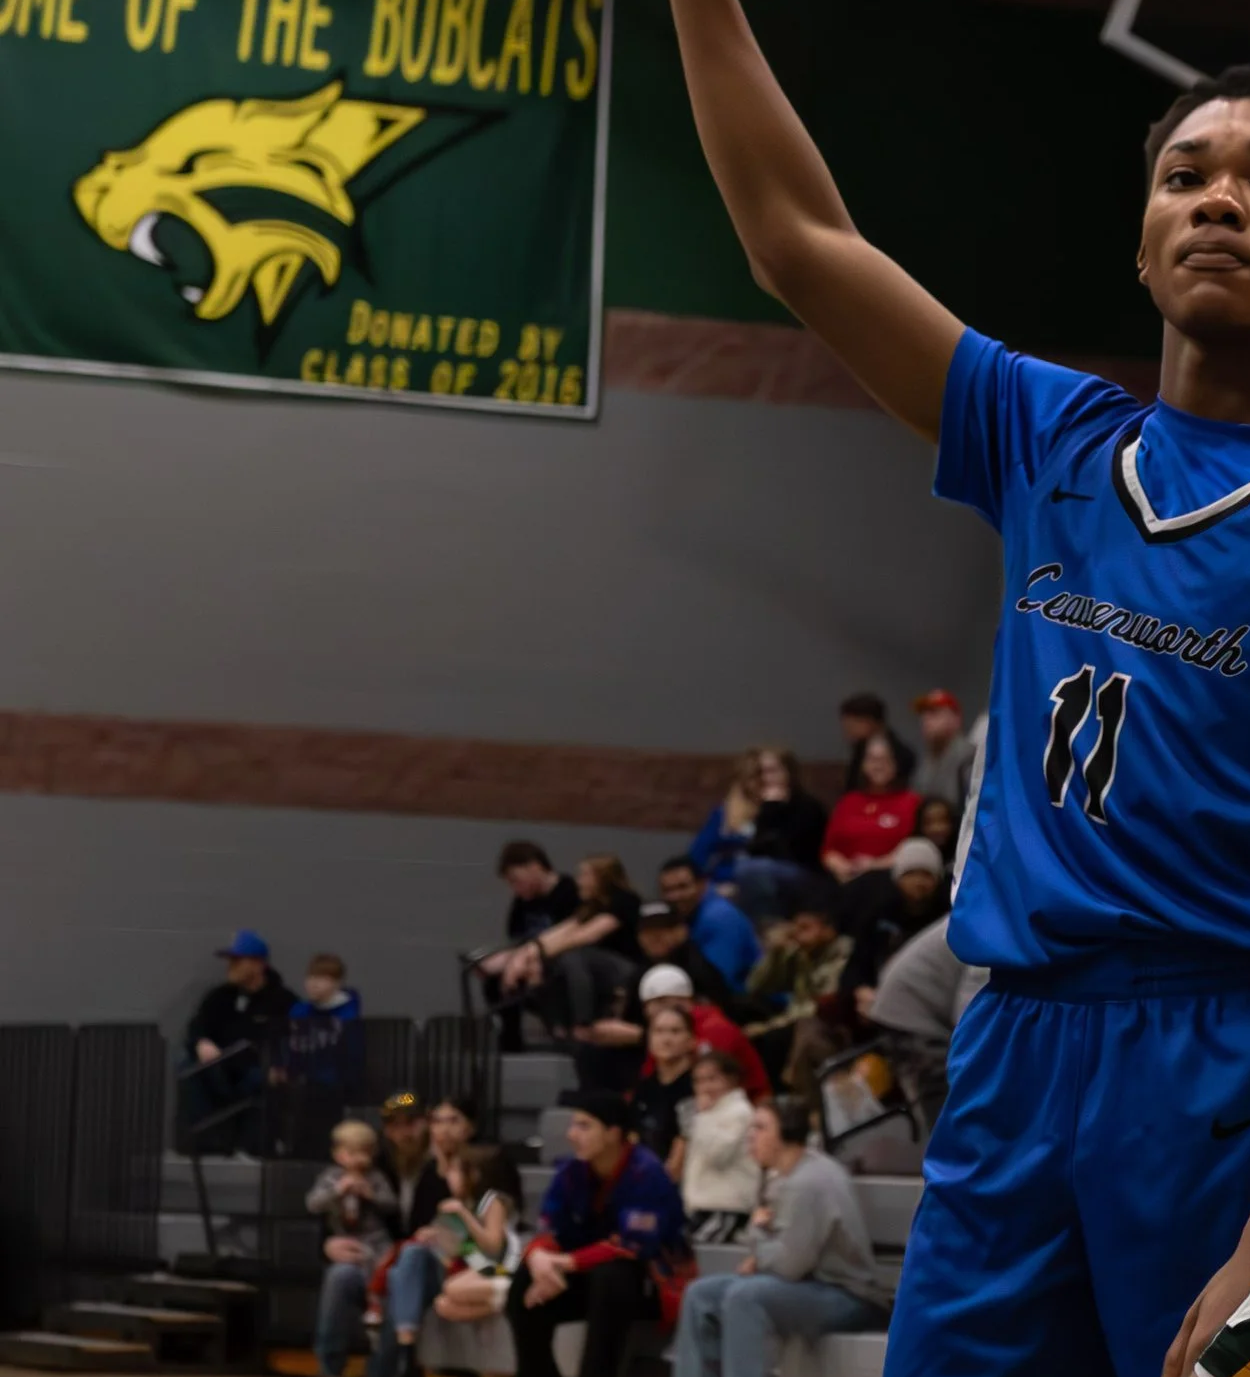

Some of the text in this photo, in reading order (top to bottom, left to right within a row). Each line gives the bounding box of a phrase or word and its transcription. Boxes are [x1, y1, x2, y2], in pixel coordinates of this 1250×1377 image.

[345, 298, 565, 361] DONATED BY
[301, 348, 584, 406] CLASS OF 2016
[1042, 663, 1132, 826] 11
